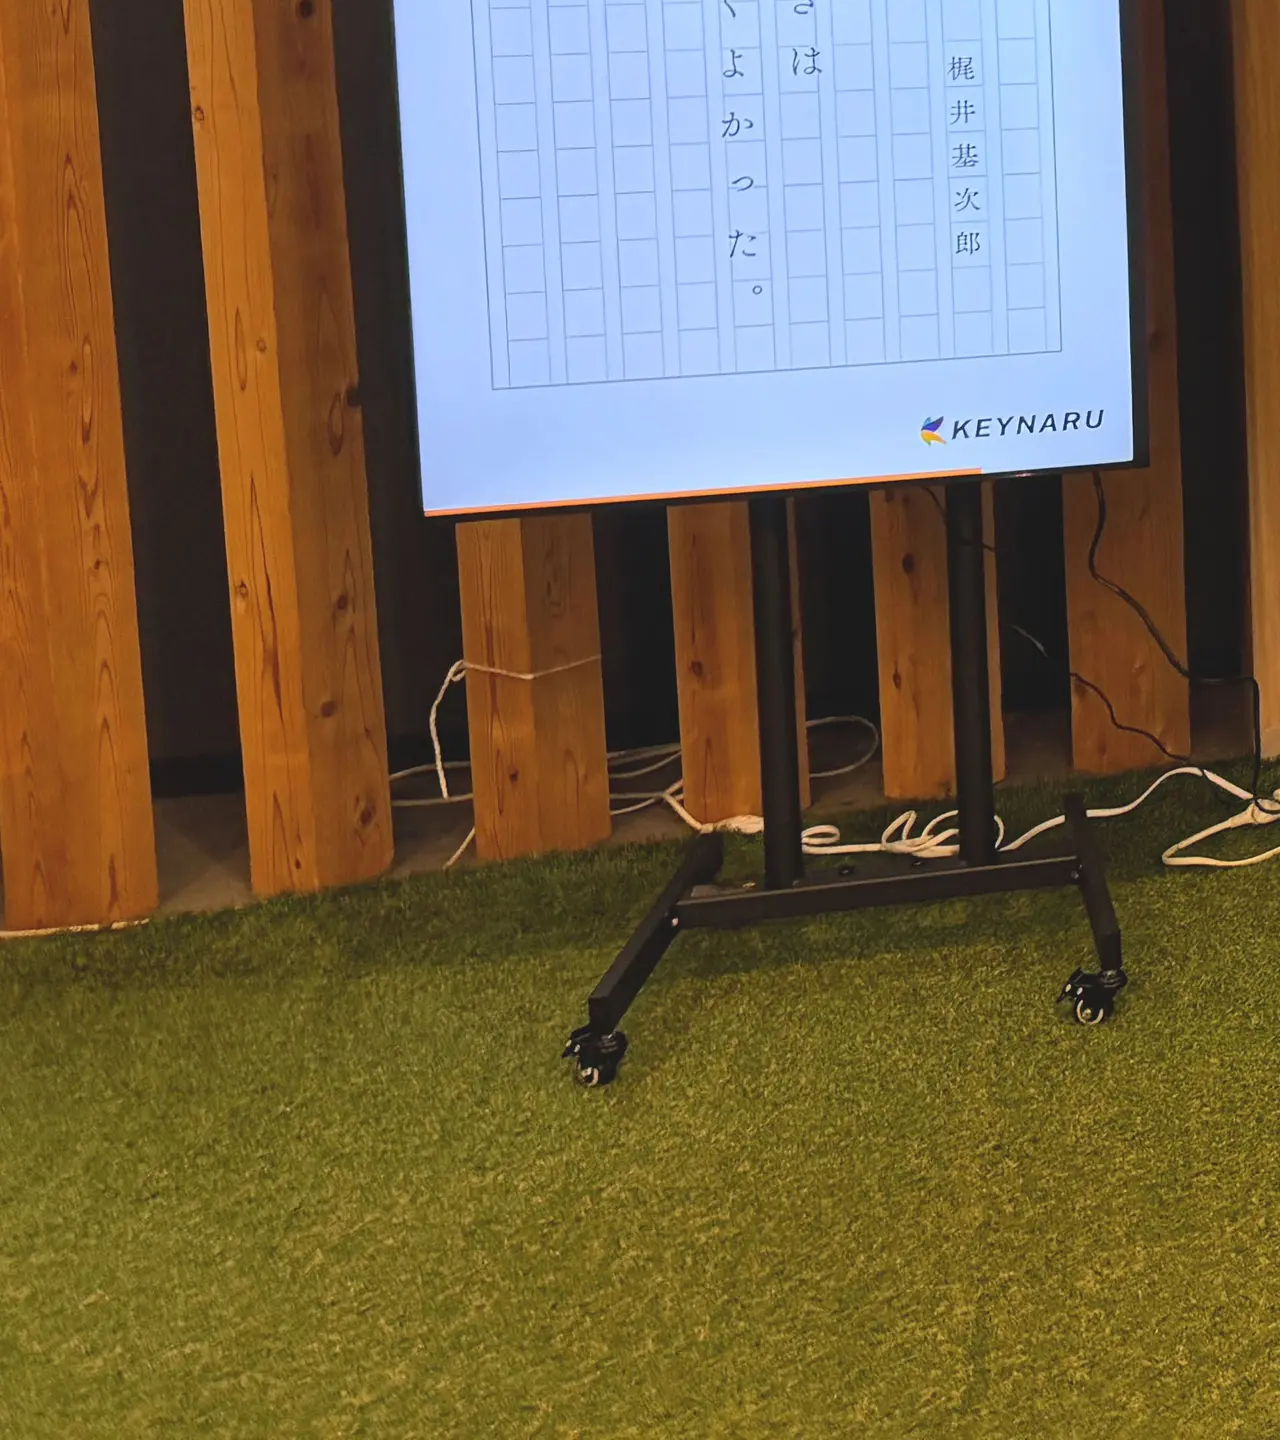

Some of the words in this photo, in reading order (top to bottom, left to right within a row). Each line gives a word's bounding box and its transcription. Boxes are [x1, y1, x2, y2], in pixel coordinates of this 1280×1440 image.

[947, 55, 981, 257] 梶井基次郎
[951, 409, 1106, 441] KEYNARU
